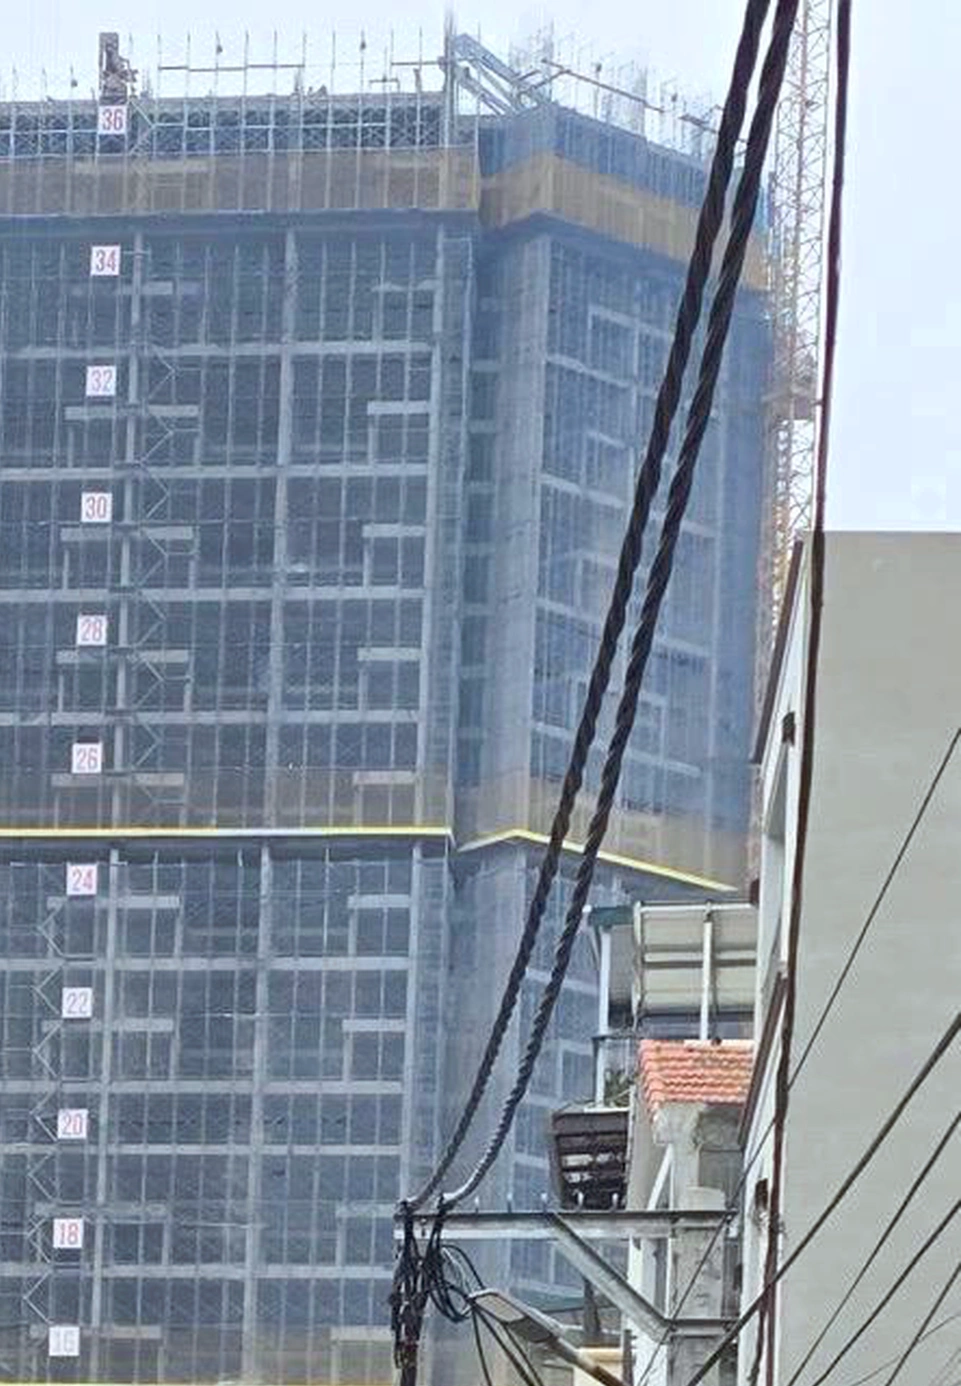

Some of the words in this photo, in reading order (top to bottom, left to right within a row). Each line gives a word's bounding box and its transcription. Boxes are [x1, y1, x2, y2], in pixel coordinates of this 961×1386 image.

[103, 109, 123, 129] 36
[96, 249, 116, 271] 34
[92, 370, 112, 391] 32
[87, 496, 107, 519] 30
[81, 619, 102, 642] 28
[77, 748, 98, 770] 26
[72, 869, 93, 892] 24
[67, 992, 88, 1014] 22
[62, 1114, 83, 1135] 20
[59, 1223, 78, 1245] 18
[55, 1329, 74, 1352] 16
